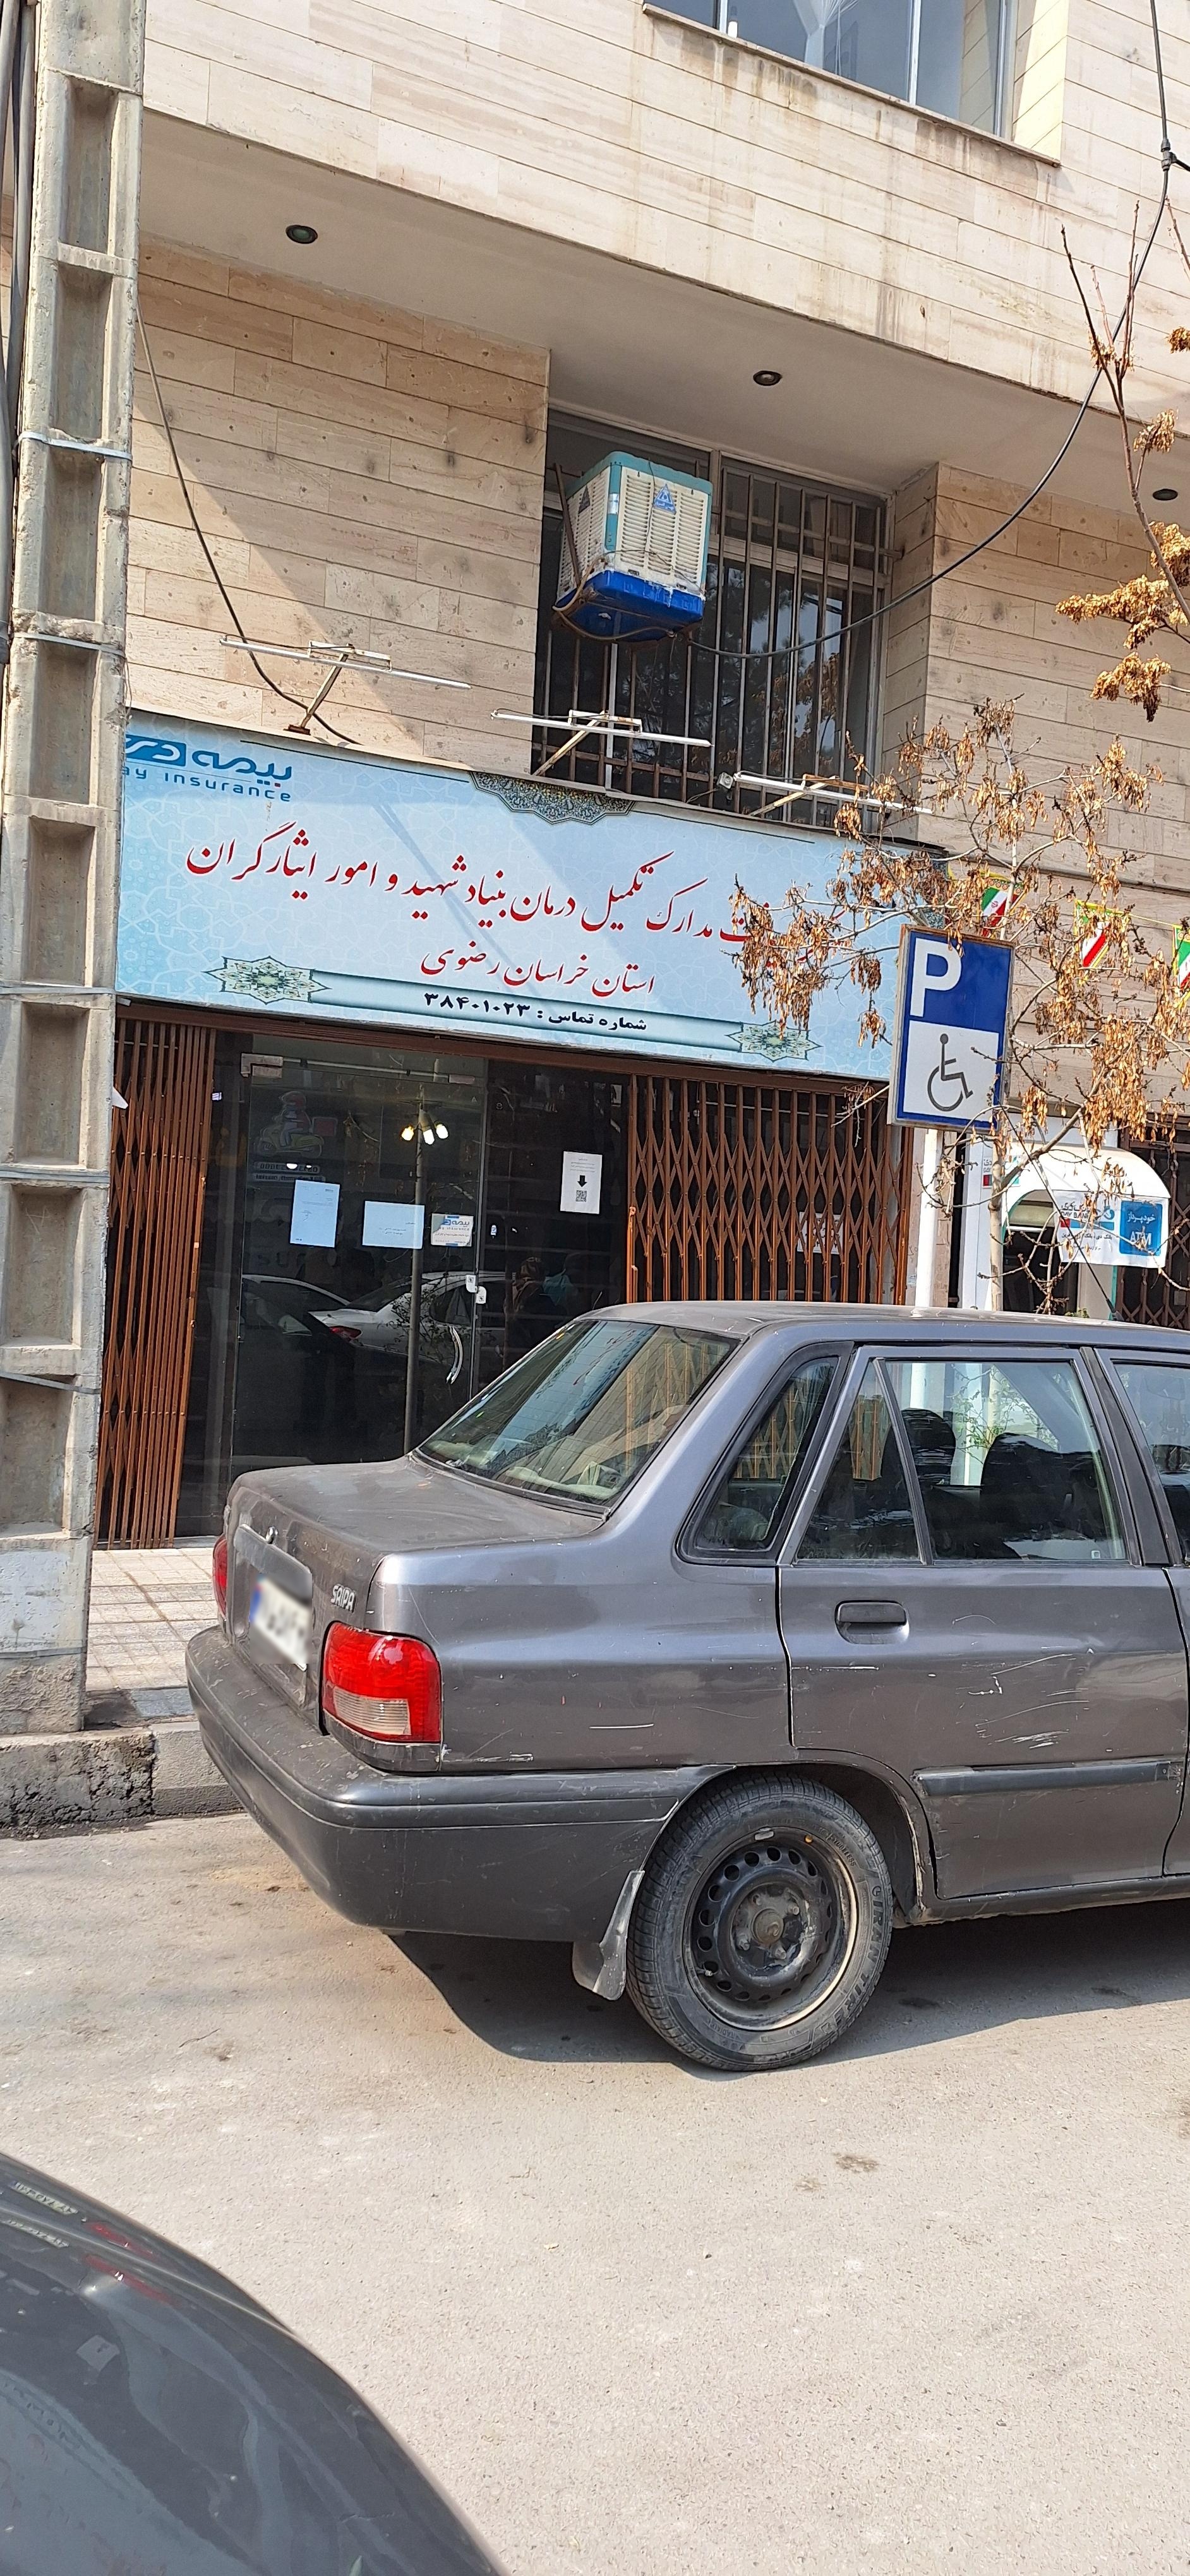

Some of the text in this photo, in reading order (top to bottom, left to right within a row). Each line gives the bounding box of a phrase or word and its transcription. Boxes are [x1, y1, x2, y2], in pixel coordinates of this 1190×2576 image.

[165, 772, 291, 802] insurance
[192, 750, 292, 787] بیمه
[186, 821, 317, 900] ایثارگران
[325, 861, 378, 888] امور
[385, 873, 399, 891] و
[401, 855, 469, 921] شهید
[465, 870, 507, 928] بنیاد
[580, 850, 675, 932] تکمیل
[510, 885, 577, 922] درمان
[646, 878, 713, 939] مدارک
[421, 941, 655, 998] استان خراسان رضوی
[910, 938, 962, 1018] P
[424, 993, 531, 1017] ۳۸۴۰۱۰۲۳
[548, 1011, 594, 1024] تماس
[598, 1017, 647, 1031] شماره
[1127, 1212, 1156, 1224] خودپرداز
[330, 1583, 356, 1612] SAIPA
[868, 1899, 884, 1962] IRAN
